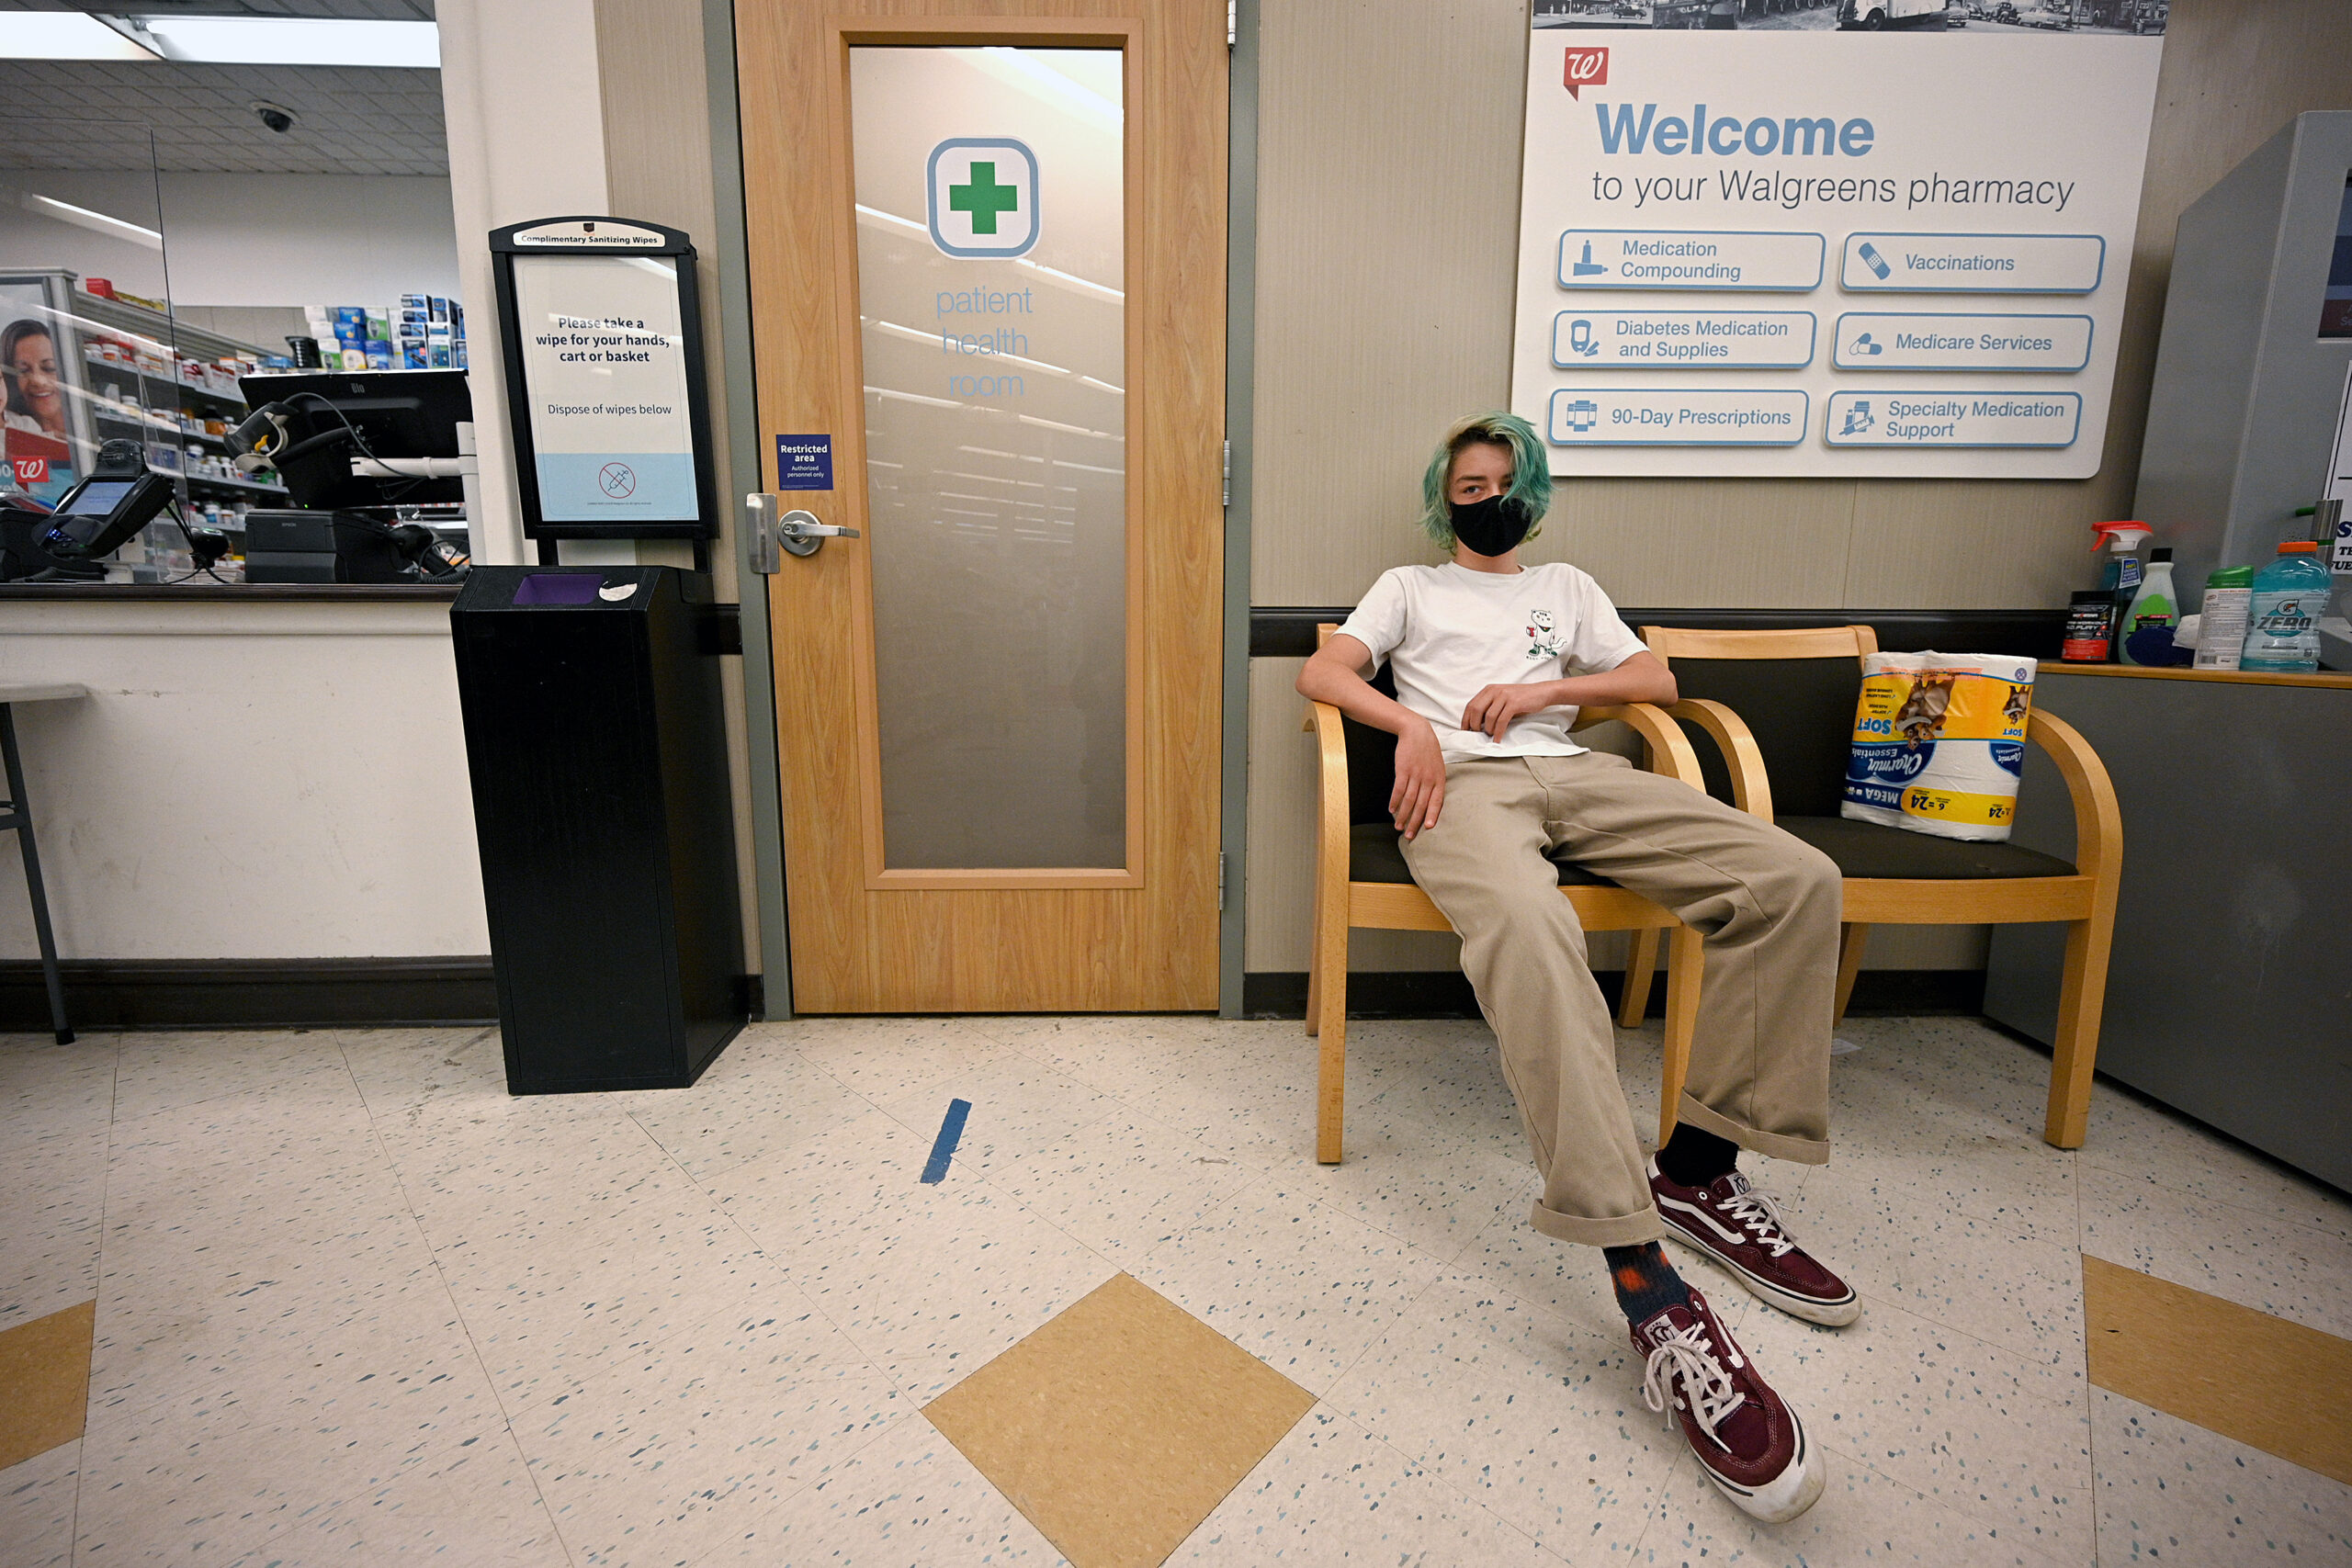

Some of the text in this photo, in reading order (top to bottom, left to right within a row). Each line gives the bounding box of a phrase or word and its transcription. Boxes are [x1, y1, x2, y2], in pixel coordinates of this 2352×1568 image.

[1596, 104, 1874, 157] Welcome
[1593, 170, 2075, 212] to your Walgreens pharmacy
[521, 234, 658, 245] Complimentary Sanitizing Wipes
[1623, 241, 1716, 256] Medication
[1906, 254, 2014, 270] Vaccinations
[1622, 262, 1740, 282] Compounding
[936, 286, 1034, 320] patient
[560, 318, 602, 328] Please
[605, 318, 633, 328] take
[1617, 321, 1788, 335] Diabetes Medication
[537, 334, 669, 348] wipe for your hands,
[943, 327, 1028, 355] health
[1896, 333, 2052, 350] Medicare Services
[560, 352, 585, 361] cart
[606, 351, 650, 361] basket
[1620, 342, 1728, 360] and Supplies
[949, 375, 1024, 397] room
[548, 404, 671, 416] Dispose of wipes below
[1612, 409, 1791, 427] 90-Day Prescriptions
[1888, 401, 2064, 422] Specialty Medication
[1886, 422, 1955, 440] Support
[781, 445, 827, 453] Restricted
[2336, 521, 2352, 537] S
[2256, 616, 2312, 630] ZERO
[1857, 717, 1893, 735] SOFT
[2002, 728, 2023, 737] SOFT
[1851, 748, 1897, 759] Essentials
[1997, 752, 2021, 763] Charmin
[1867, 753, 1922, 775] Charmin
[1865, 787, 1898, 804] MEGA
[1911, 795, 1928, 810] 24
[1988, 807, 2002, 818] 24
